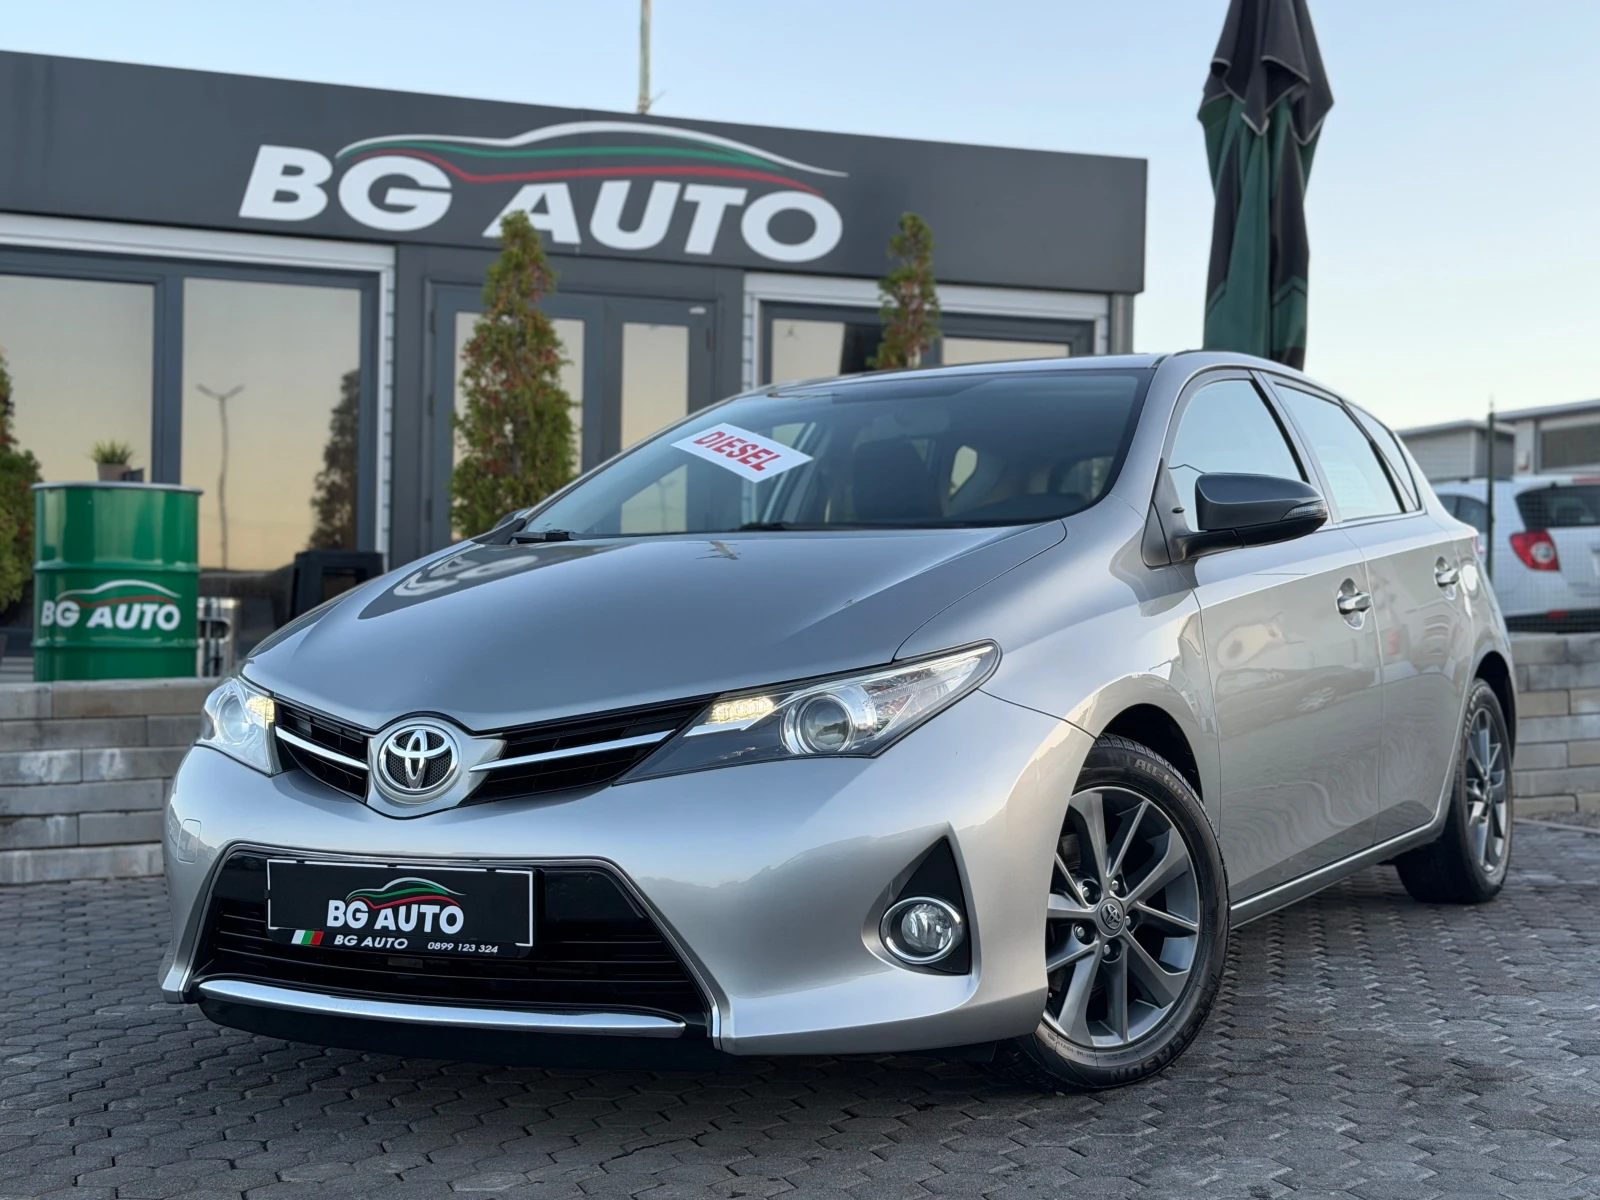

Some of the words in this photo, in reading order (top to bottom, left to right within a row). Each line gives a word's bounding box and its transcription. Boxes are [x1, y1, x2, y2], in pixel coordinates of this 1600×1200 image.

[238, 144, 452, 231] BG
[482, 179, 843, 263] AUTO
[692, 430, 781, 471] DIESEL
[40, 600, 80, 628] BG
[86, 603, 181, 631] AUTO
[326, 899, 368, 929] BG
[373, 904, 464, 934] AUTO
[333, 934, 359, 947] BG
[360, 936, 408, 950] AUTO
[427, 941, 454, 951] 0899
[457, 943, 476, 952] 123
[478, 944, 498, 954] 324
